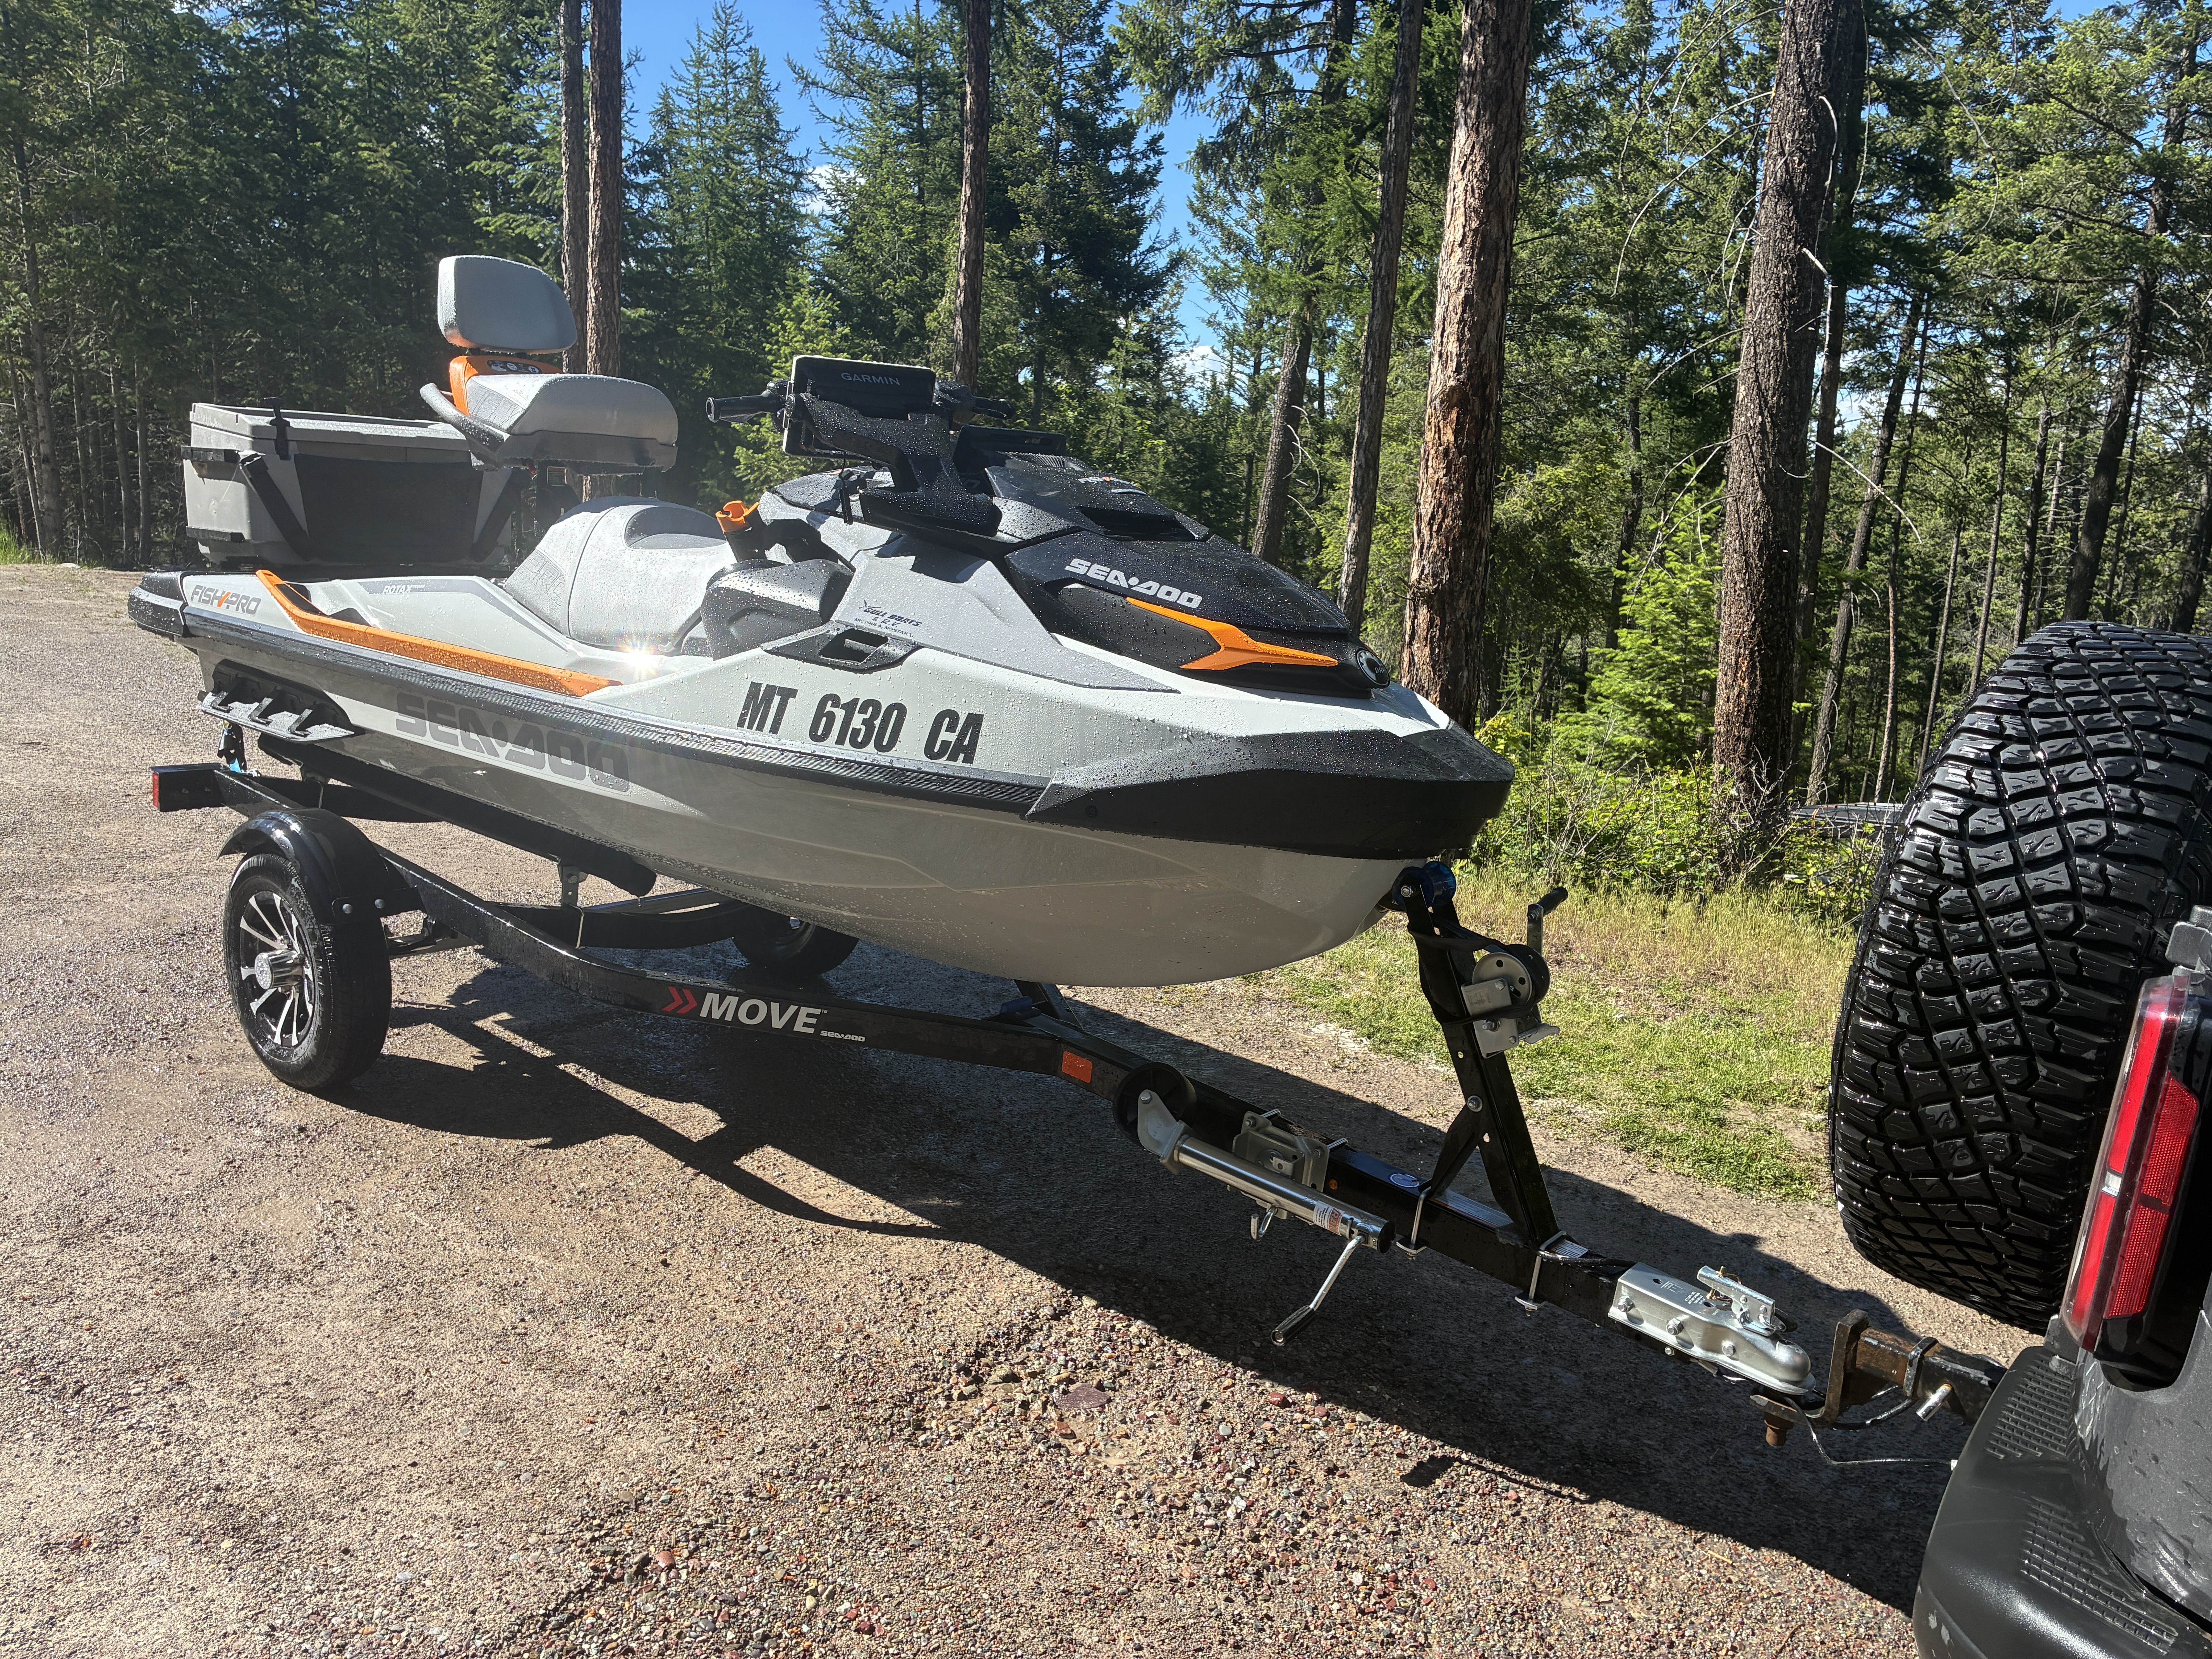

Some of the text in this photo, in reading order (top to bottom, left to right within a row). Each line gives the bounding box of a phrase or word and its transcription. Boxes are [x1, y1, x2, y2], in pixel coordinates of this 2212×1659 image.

[841, 373, 900, 385] GARMIN
[382, 585, 413, 594] ROTAX
[863, 608, 922, 627] GULL BOATS
[737, 681, 985, 765] MT 6130 CA
[699, 992, 821, 1034] MOVE
